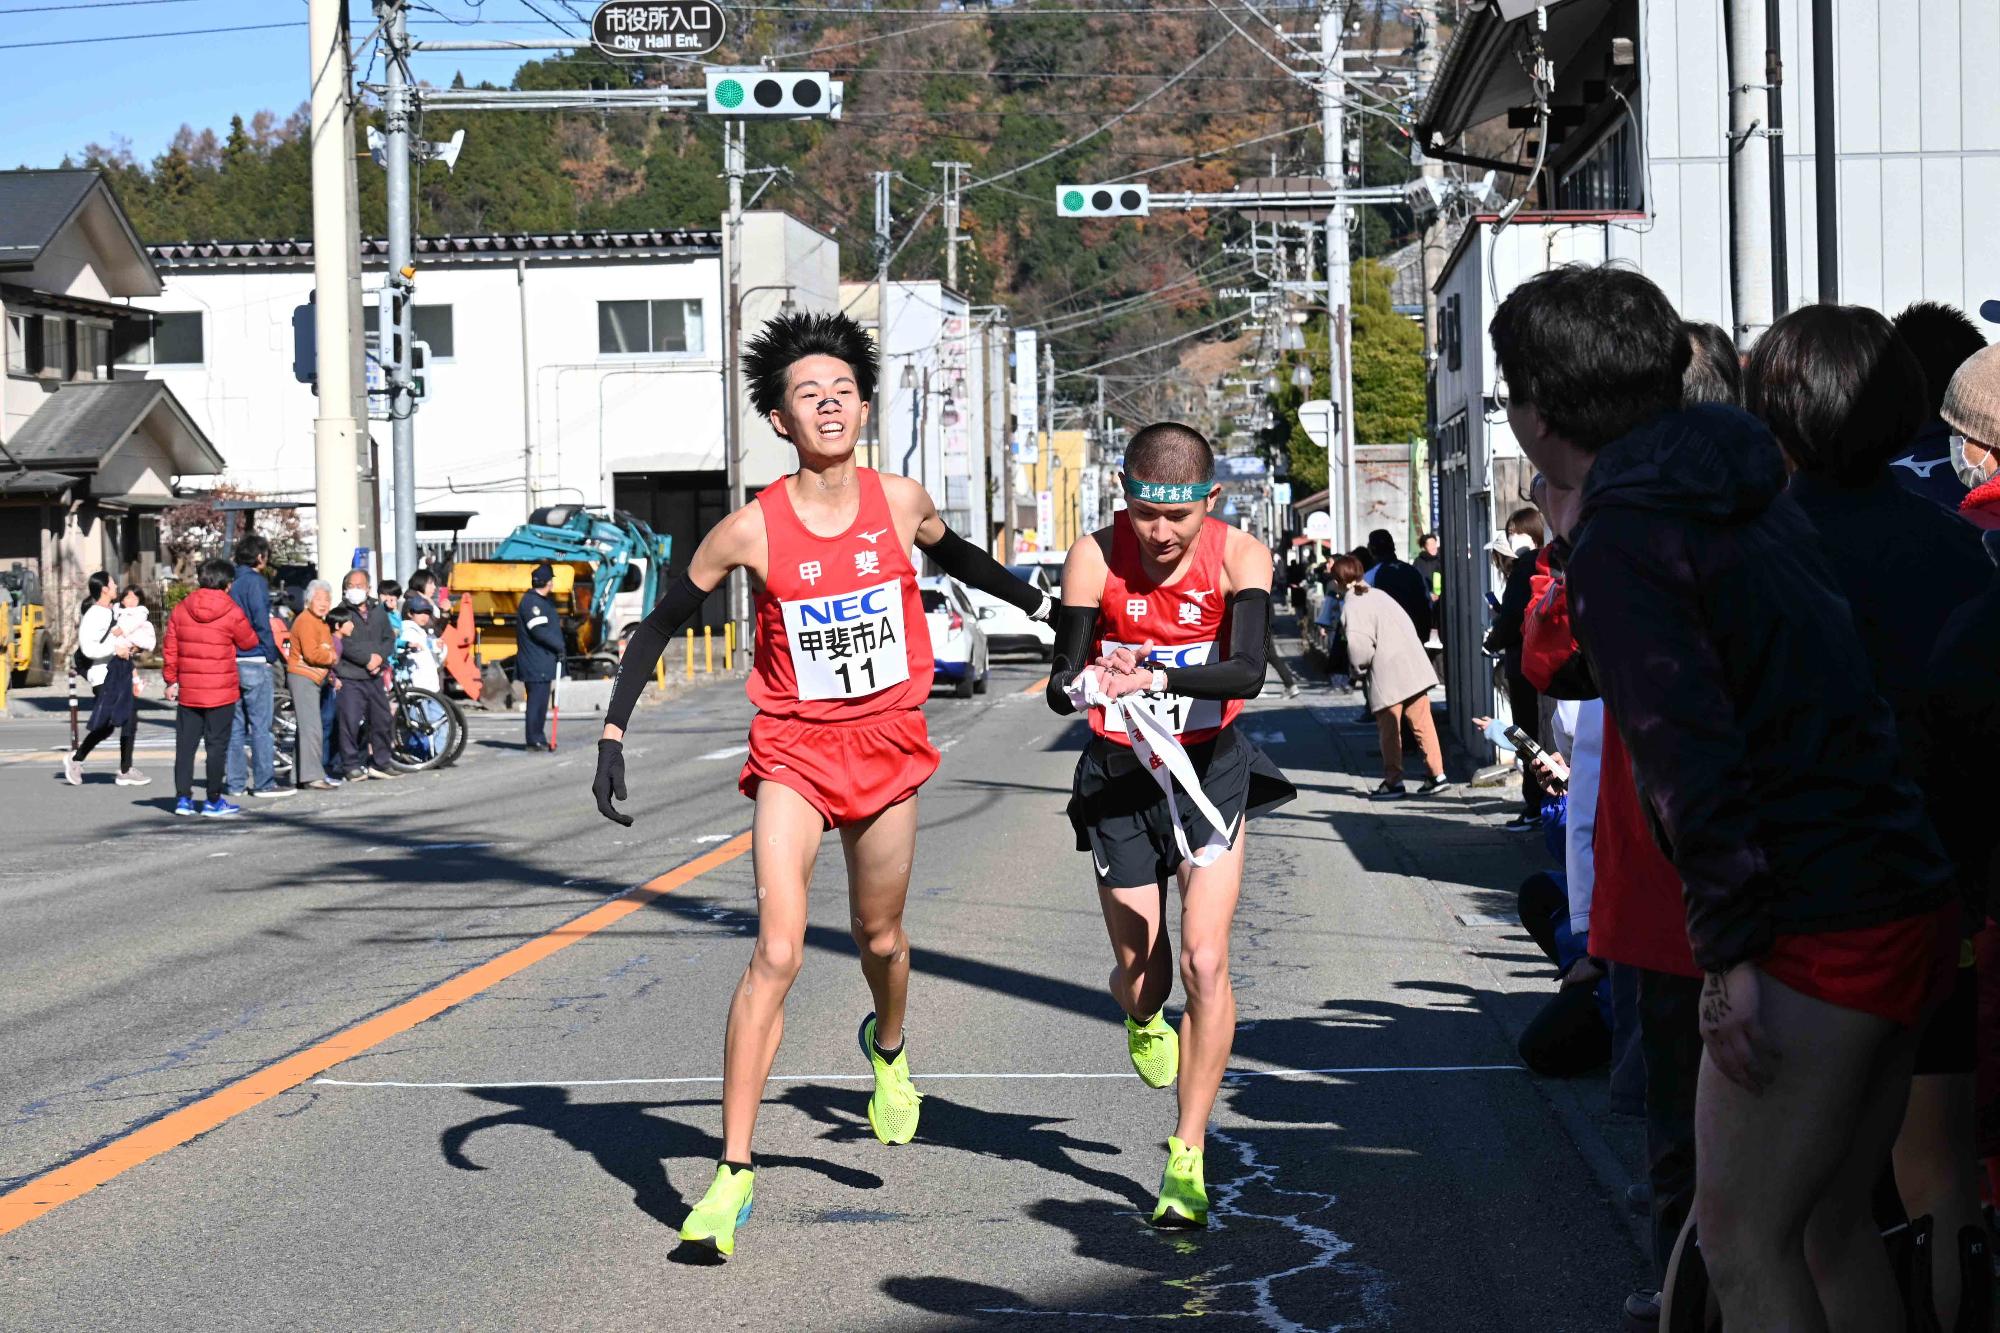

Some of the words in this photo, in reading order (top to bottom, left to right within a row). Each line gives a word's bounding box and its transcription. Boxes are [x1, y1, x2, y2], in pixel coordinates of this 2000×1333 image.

[605, 7, 711, 32] 市役所入口
[614, 35, 641, 51] City
[645, 34, 671, 48] Hall
[675, 33, 702, 48] Ent.
[800, 588, 888, 626] NEC
[798, 616, 896, 661] 甲斐市A
[1140, 646, 1202, 668] EC
[835, 658, 876, 693] 11
